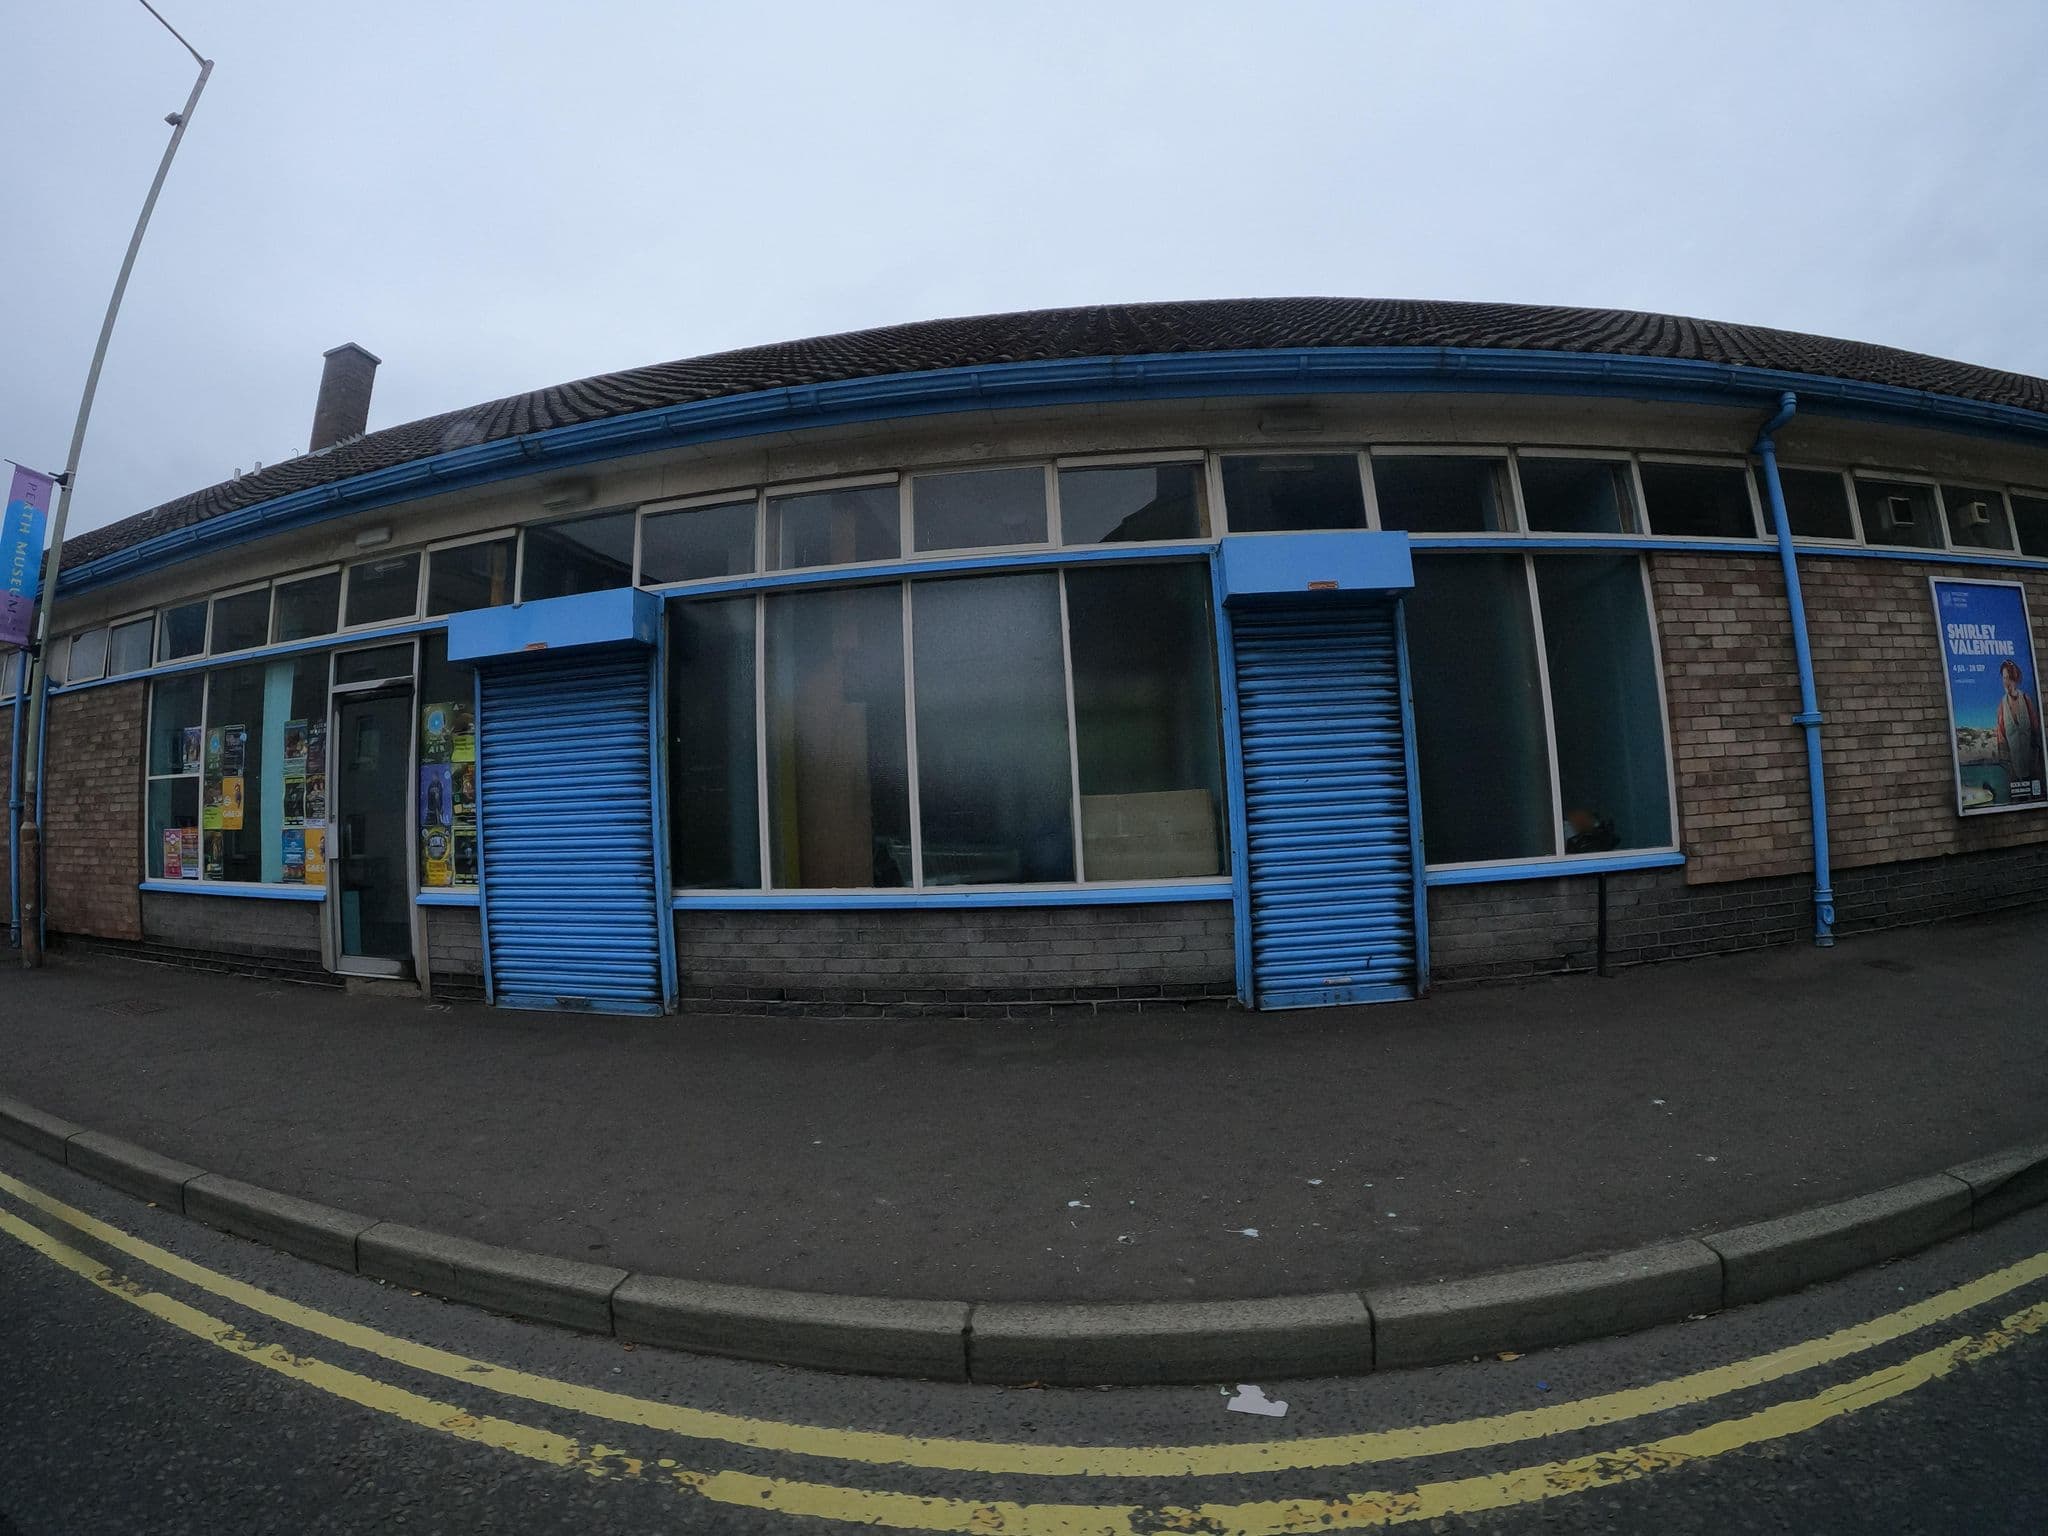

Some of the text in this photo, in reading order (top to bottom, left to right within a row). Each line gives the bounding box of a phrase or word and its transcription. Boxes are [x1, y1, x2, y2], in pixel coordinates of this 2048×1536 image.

[7, 482, 38, 614] PERTH MUSEUM
[1947, 623, 1996, 639] SHIRLEY
[1949, 640, 2015, 656] VALENTINE
